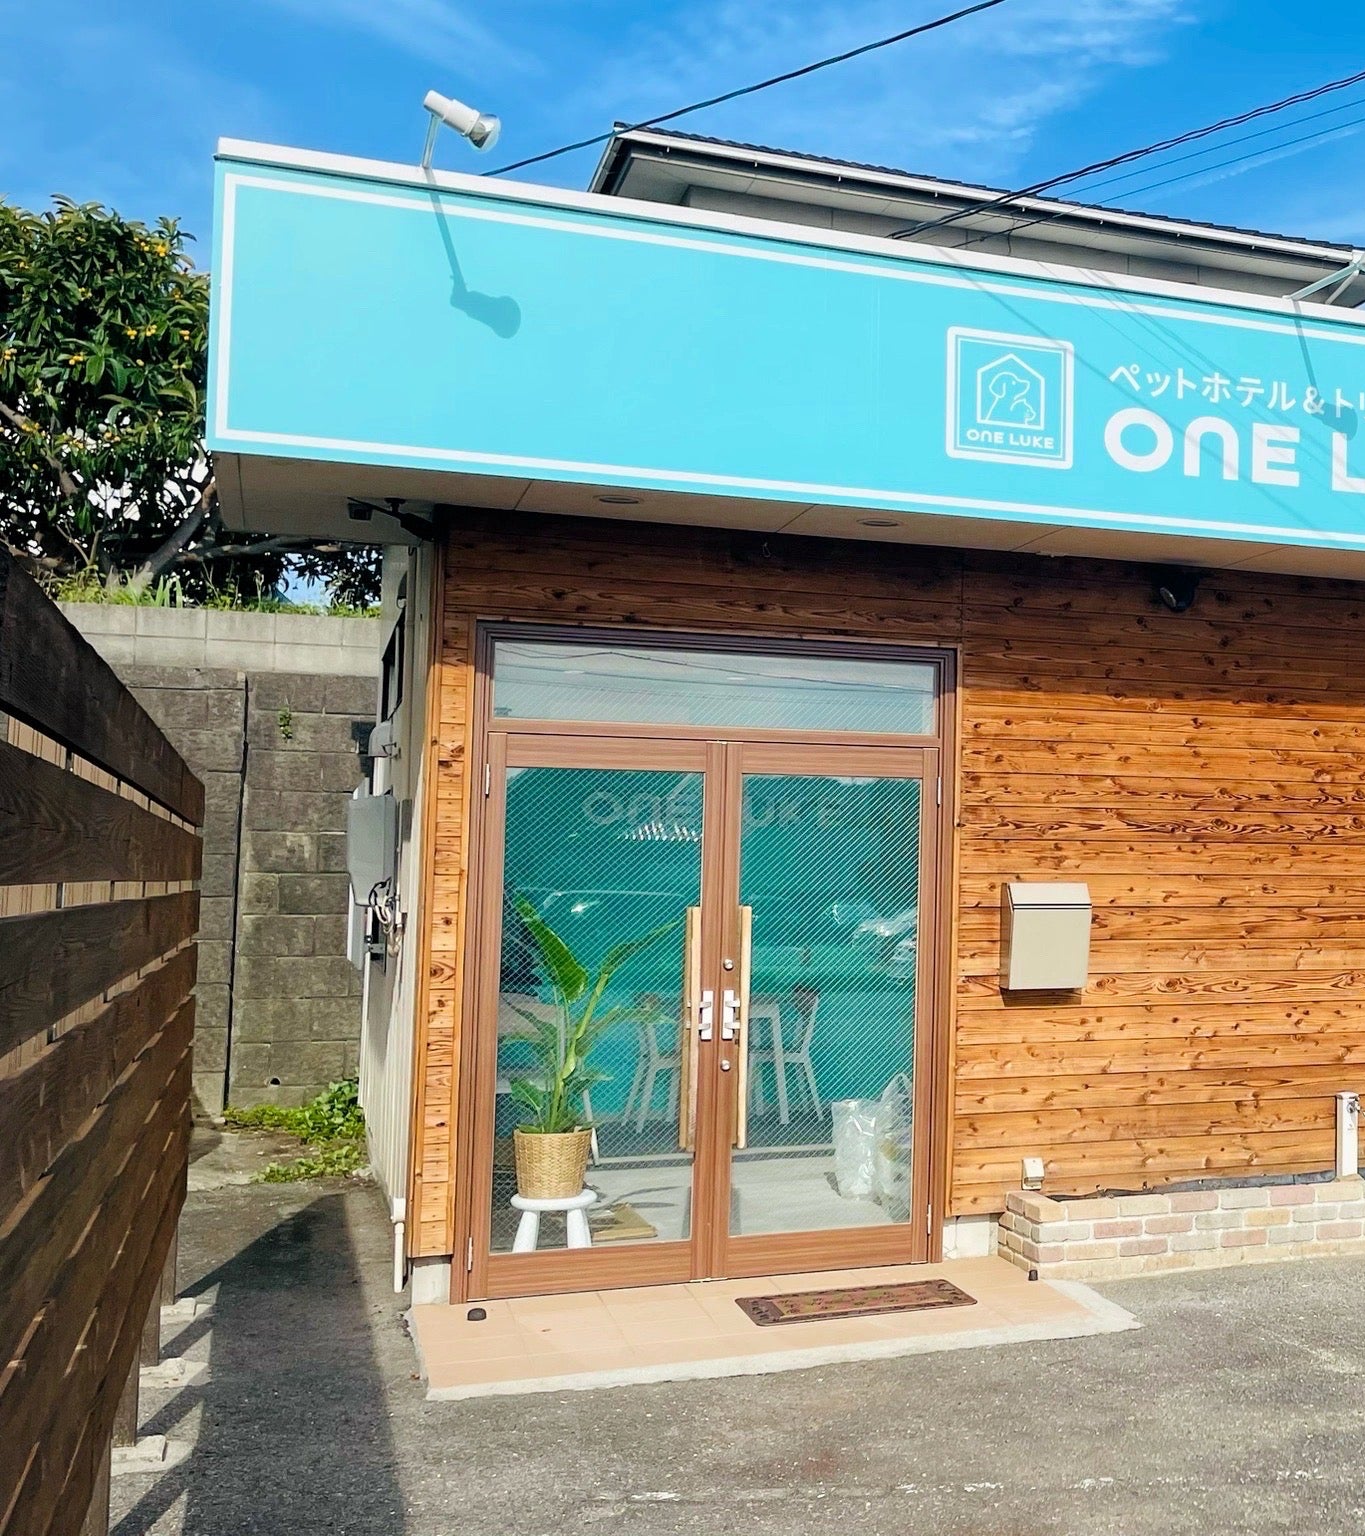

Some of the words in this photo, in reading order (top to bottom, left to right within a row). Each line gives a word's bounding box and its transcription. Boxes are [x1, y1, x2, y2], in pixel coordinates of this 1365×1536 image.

[966, 428, 1005, 444] ONE
[1009, 432, 1055, 450] LUKE
[1104, 407, 1300, 487] ONE
